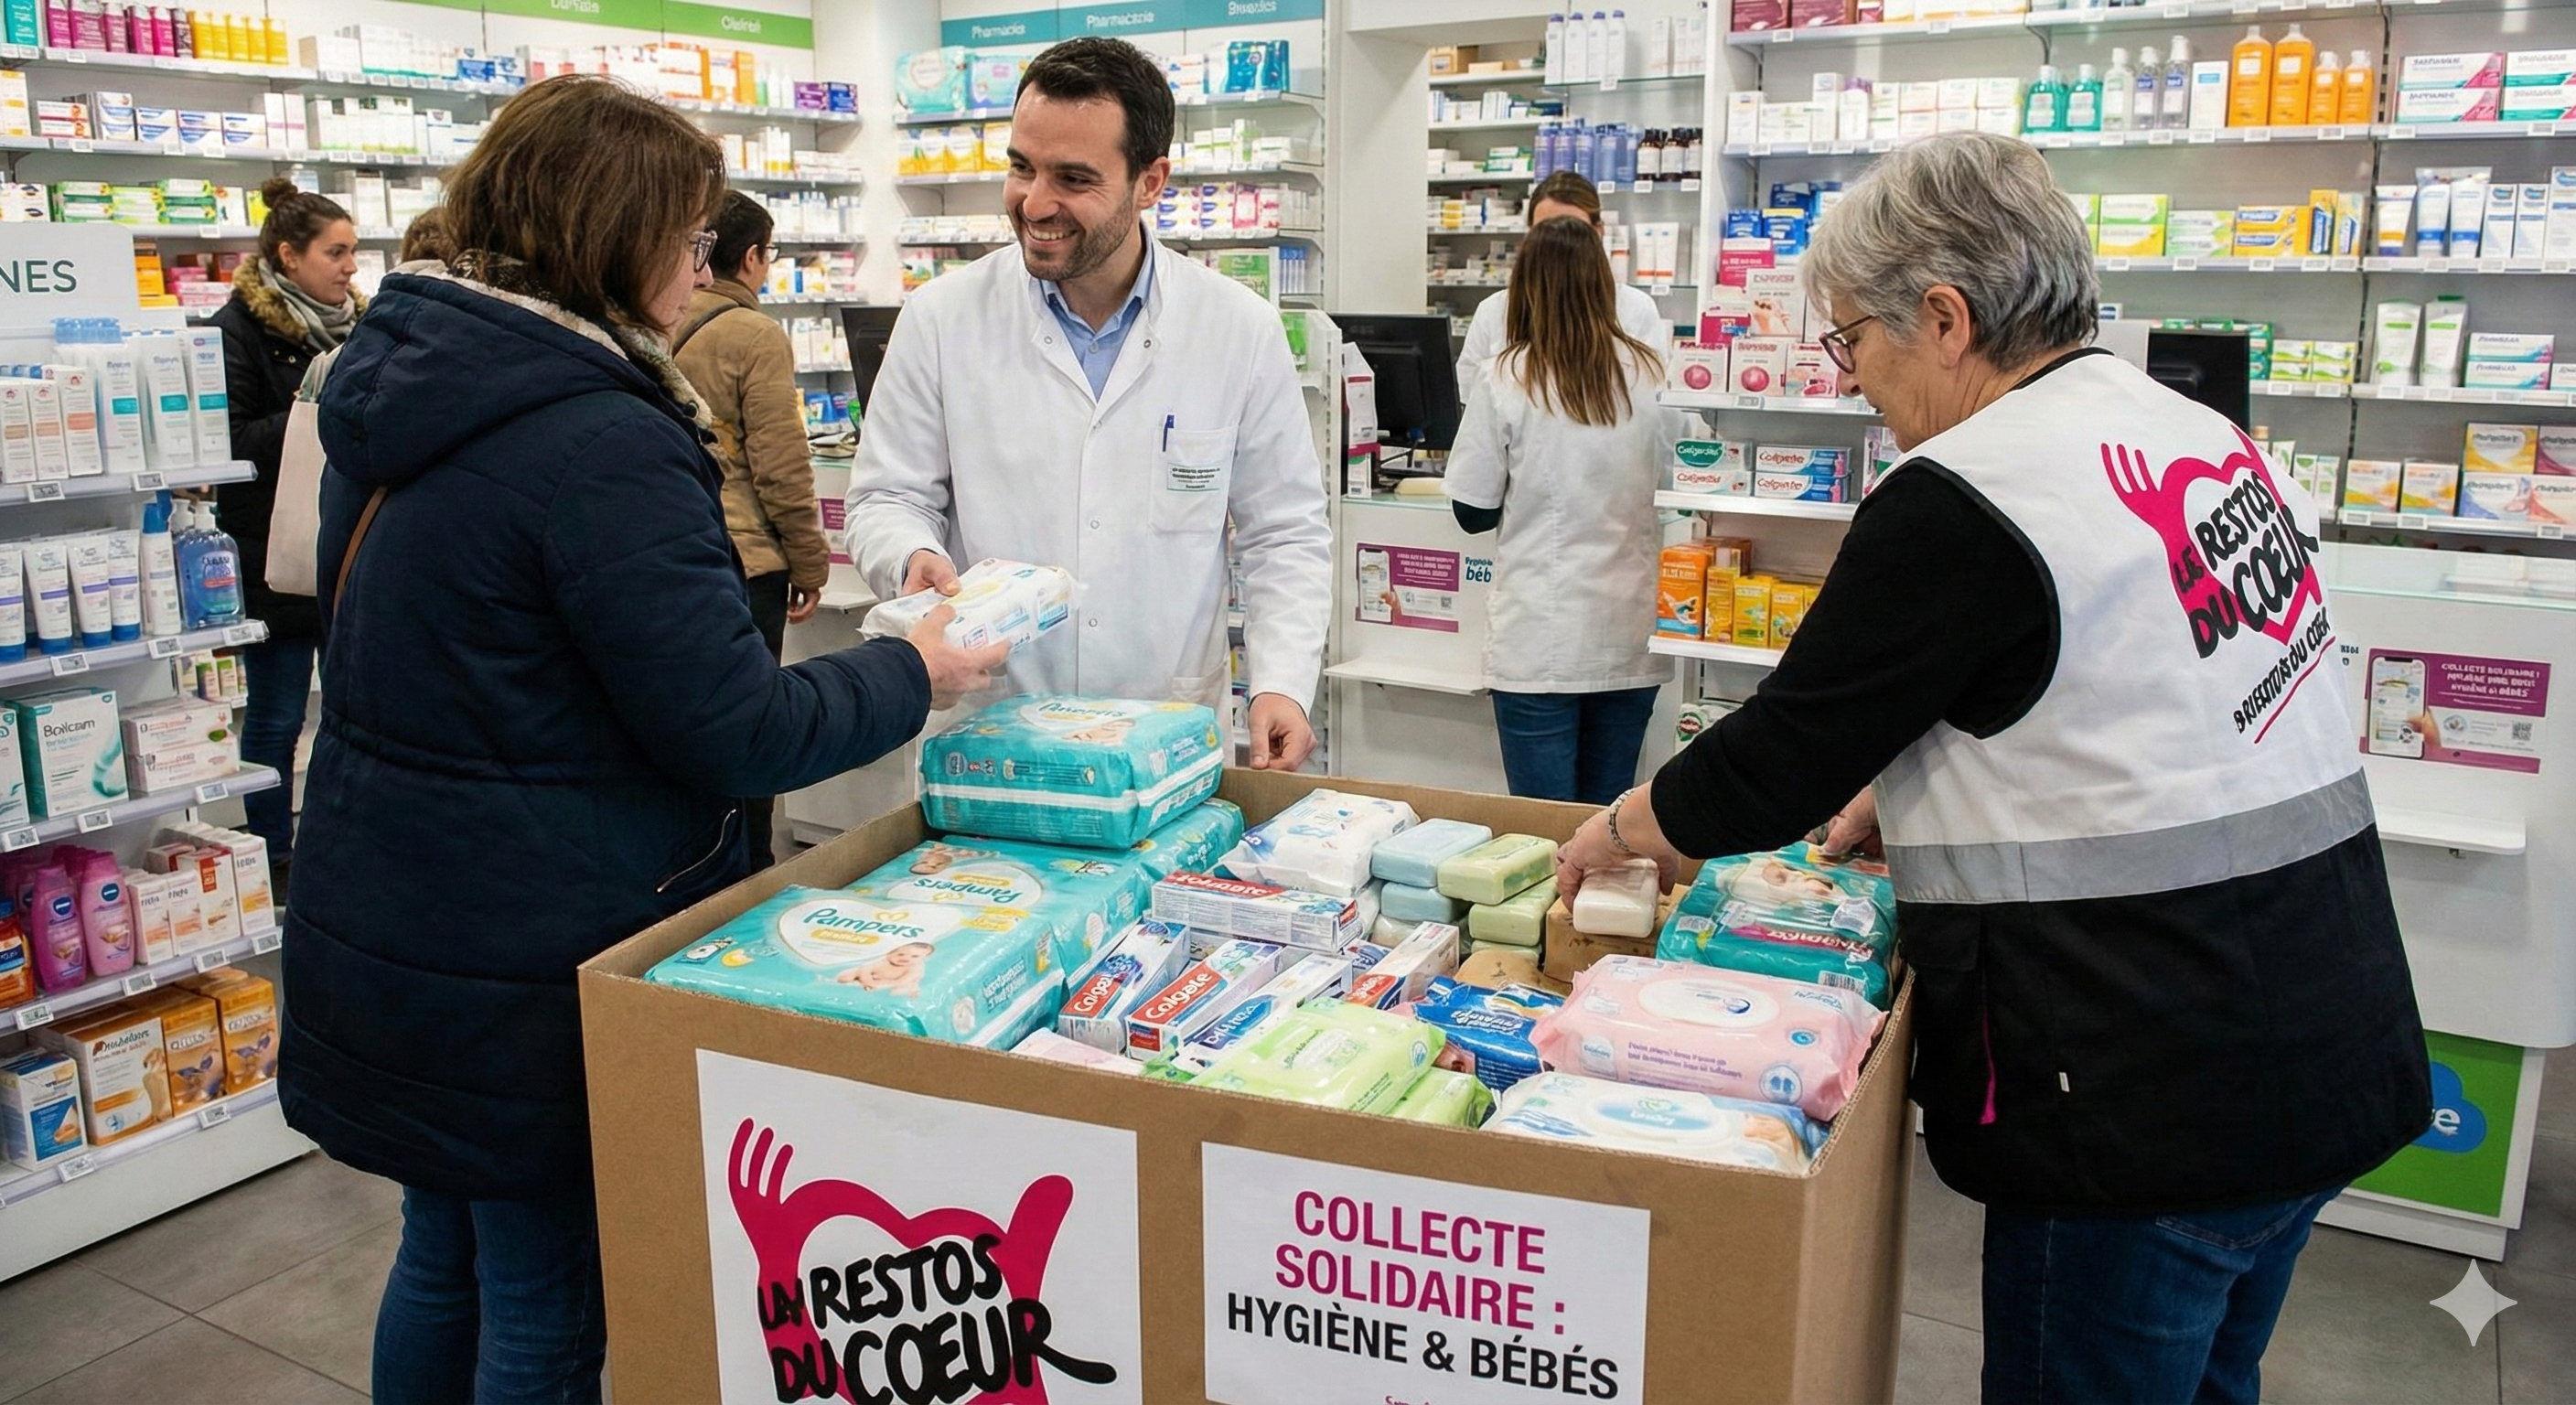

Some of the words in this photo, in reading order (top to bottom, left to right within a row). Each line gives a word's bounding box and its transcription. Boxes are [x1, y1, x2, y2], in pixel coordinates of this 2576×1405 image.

[2195, 471, 2276, 572] RESTOS
[2189, 586, 2239, 660] DU
[803, 907, 925, 938] Pampers
[914, 878, 1023, 904] Pampers
[2431, 1108, 2461, 1136] e
[1295, 1191, 1546, 1274] COLLECTE
[810, 1234, 1003, 1329] RESTOS
[1275, 1244, 1534, 1330] SOLIDAIRE
[771, 1338, 838, 1404] DU
[1228, 1292, 1408, 1363] HYGIÈNE
[1422, 1331, 1455, 1372] &
[1470, 1335, 1619, 1400] BÉBÉS
